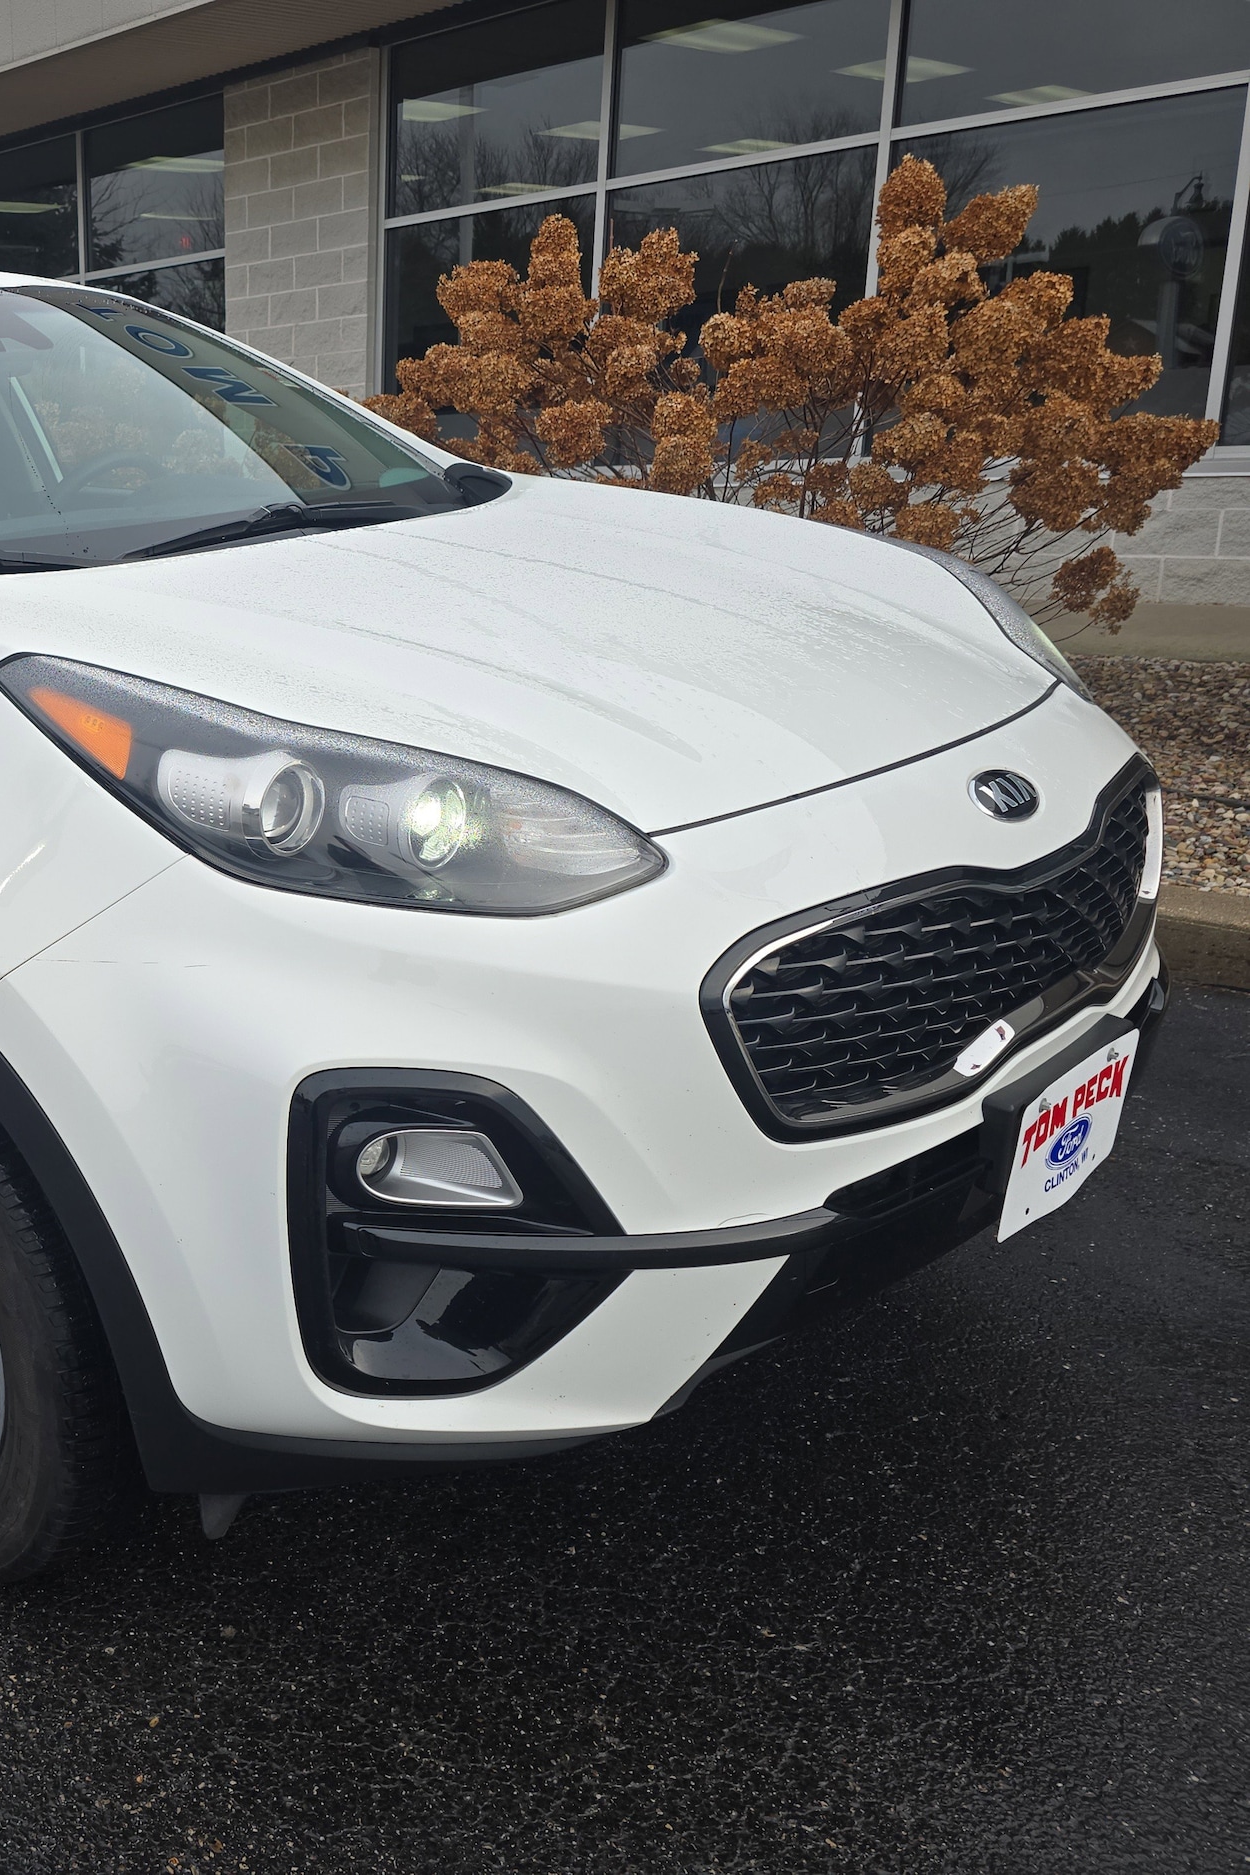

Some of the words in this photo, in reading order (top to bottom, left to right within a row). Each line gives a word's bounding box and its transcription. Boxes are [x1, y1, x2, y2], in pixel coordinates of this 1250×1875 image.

[1021, 1096, 1069, 1168] TOM
[1072, 1055, 1129, 1118] PECK
[1058, 1125, 1084, 1160] Ford
